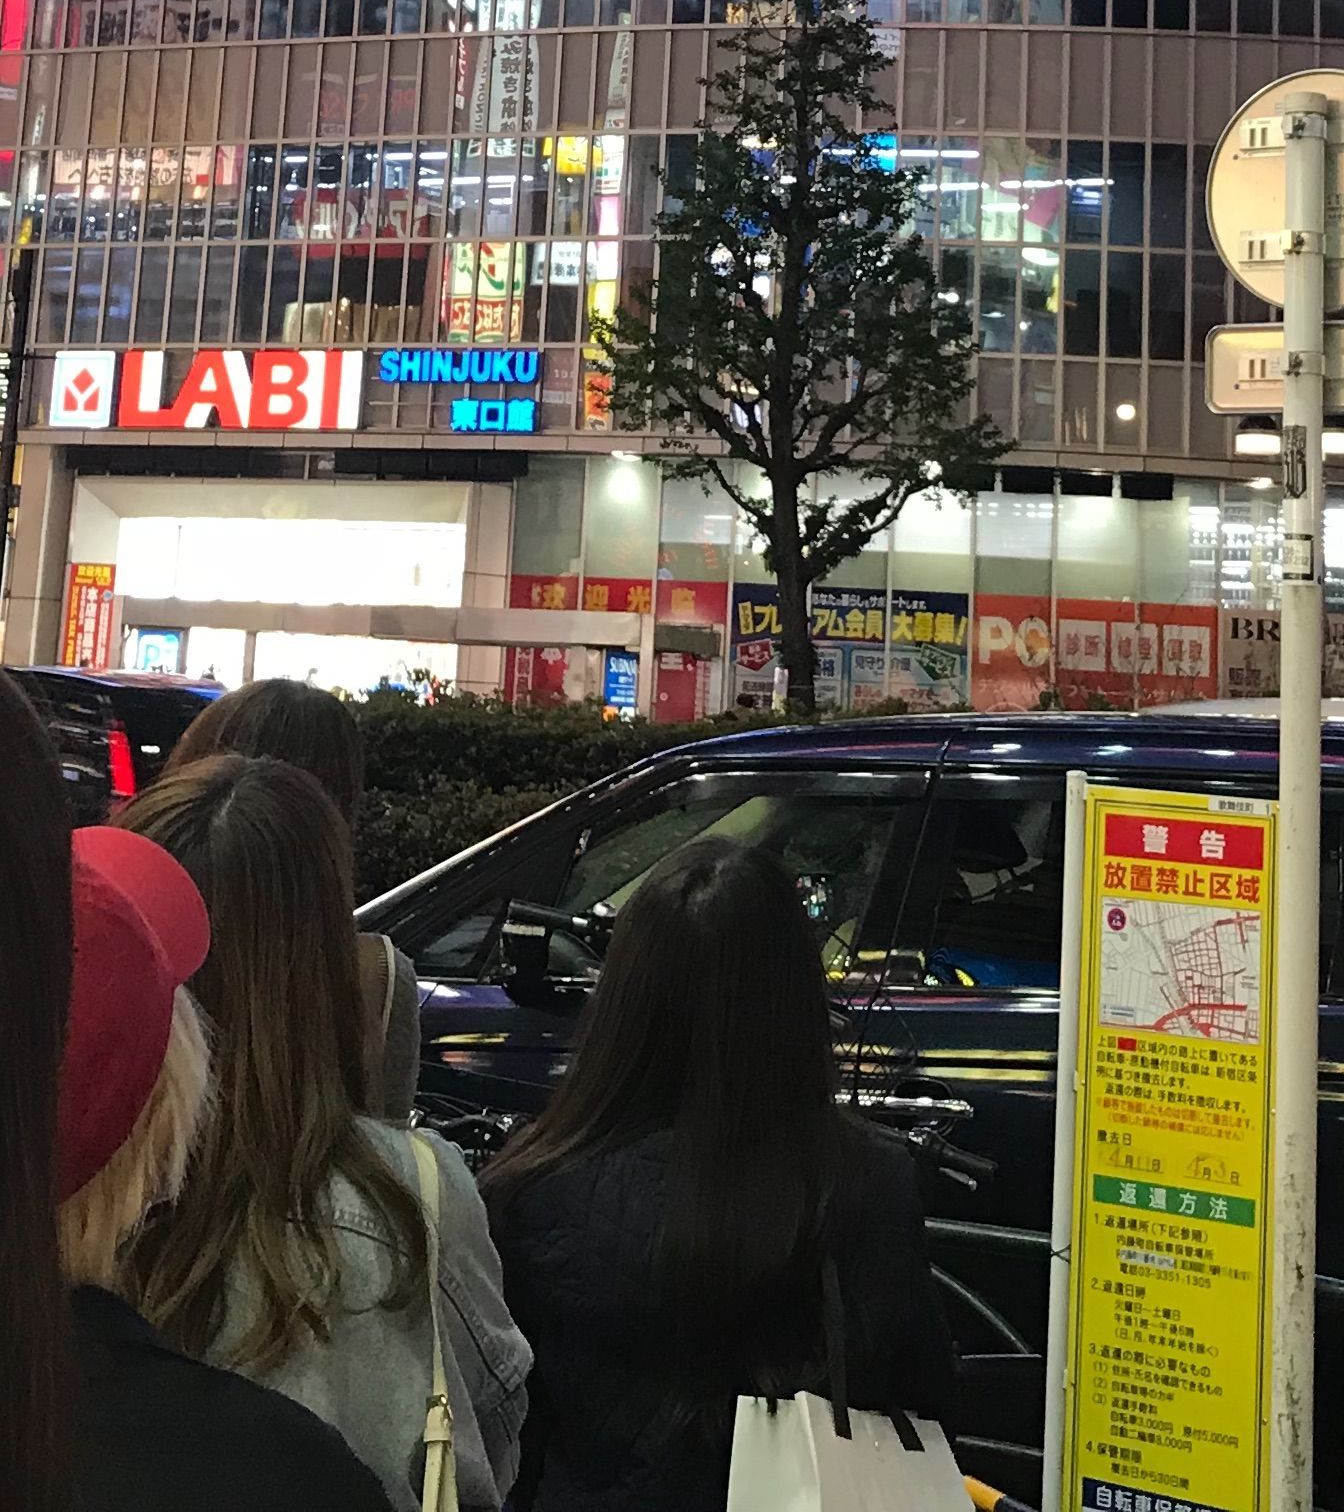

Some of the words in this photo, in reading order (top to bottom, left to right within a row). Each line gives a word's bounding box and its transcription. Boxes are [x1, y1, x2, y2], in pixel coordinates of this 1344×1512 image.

[379, 349, 540, 384] SHINJUKU
[118, 350, 362, 429] LABI
[978, 615, 1052, 666] PC
[1142, 824, 1227, 860] 警告
[1103, 862, 1261, 905] 放置禁止区域
